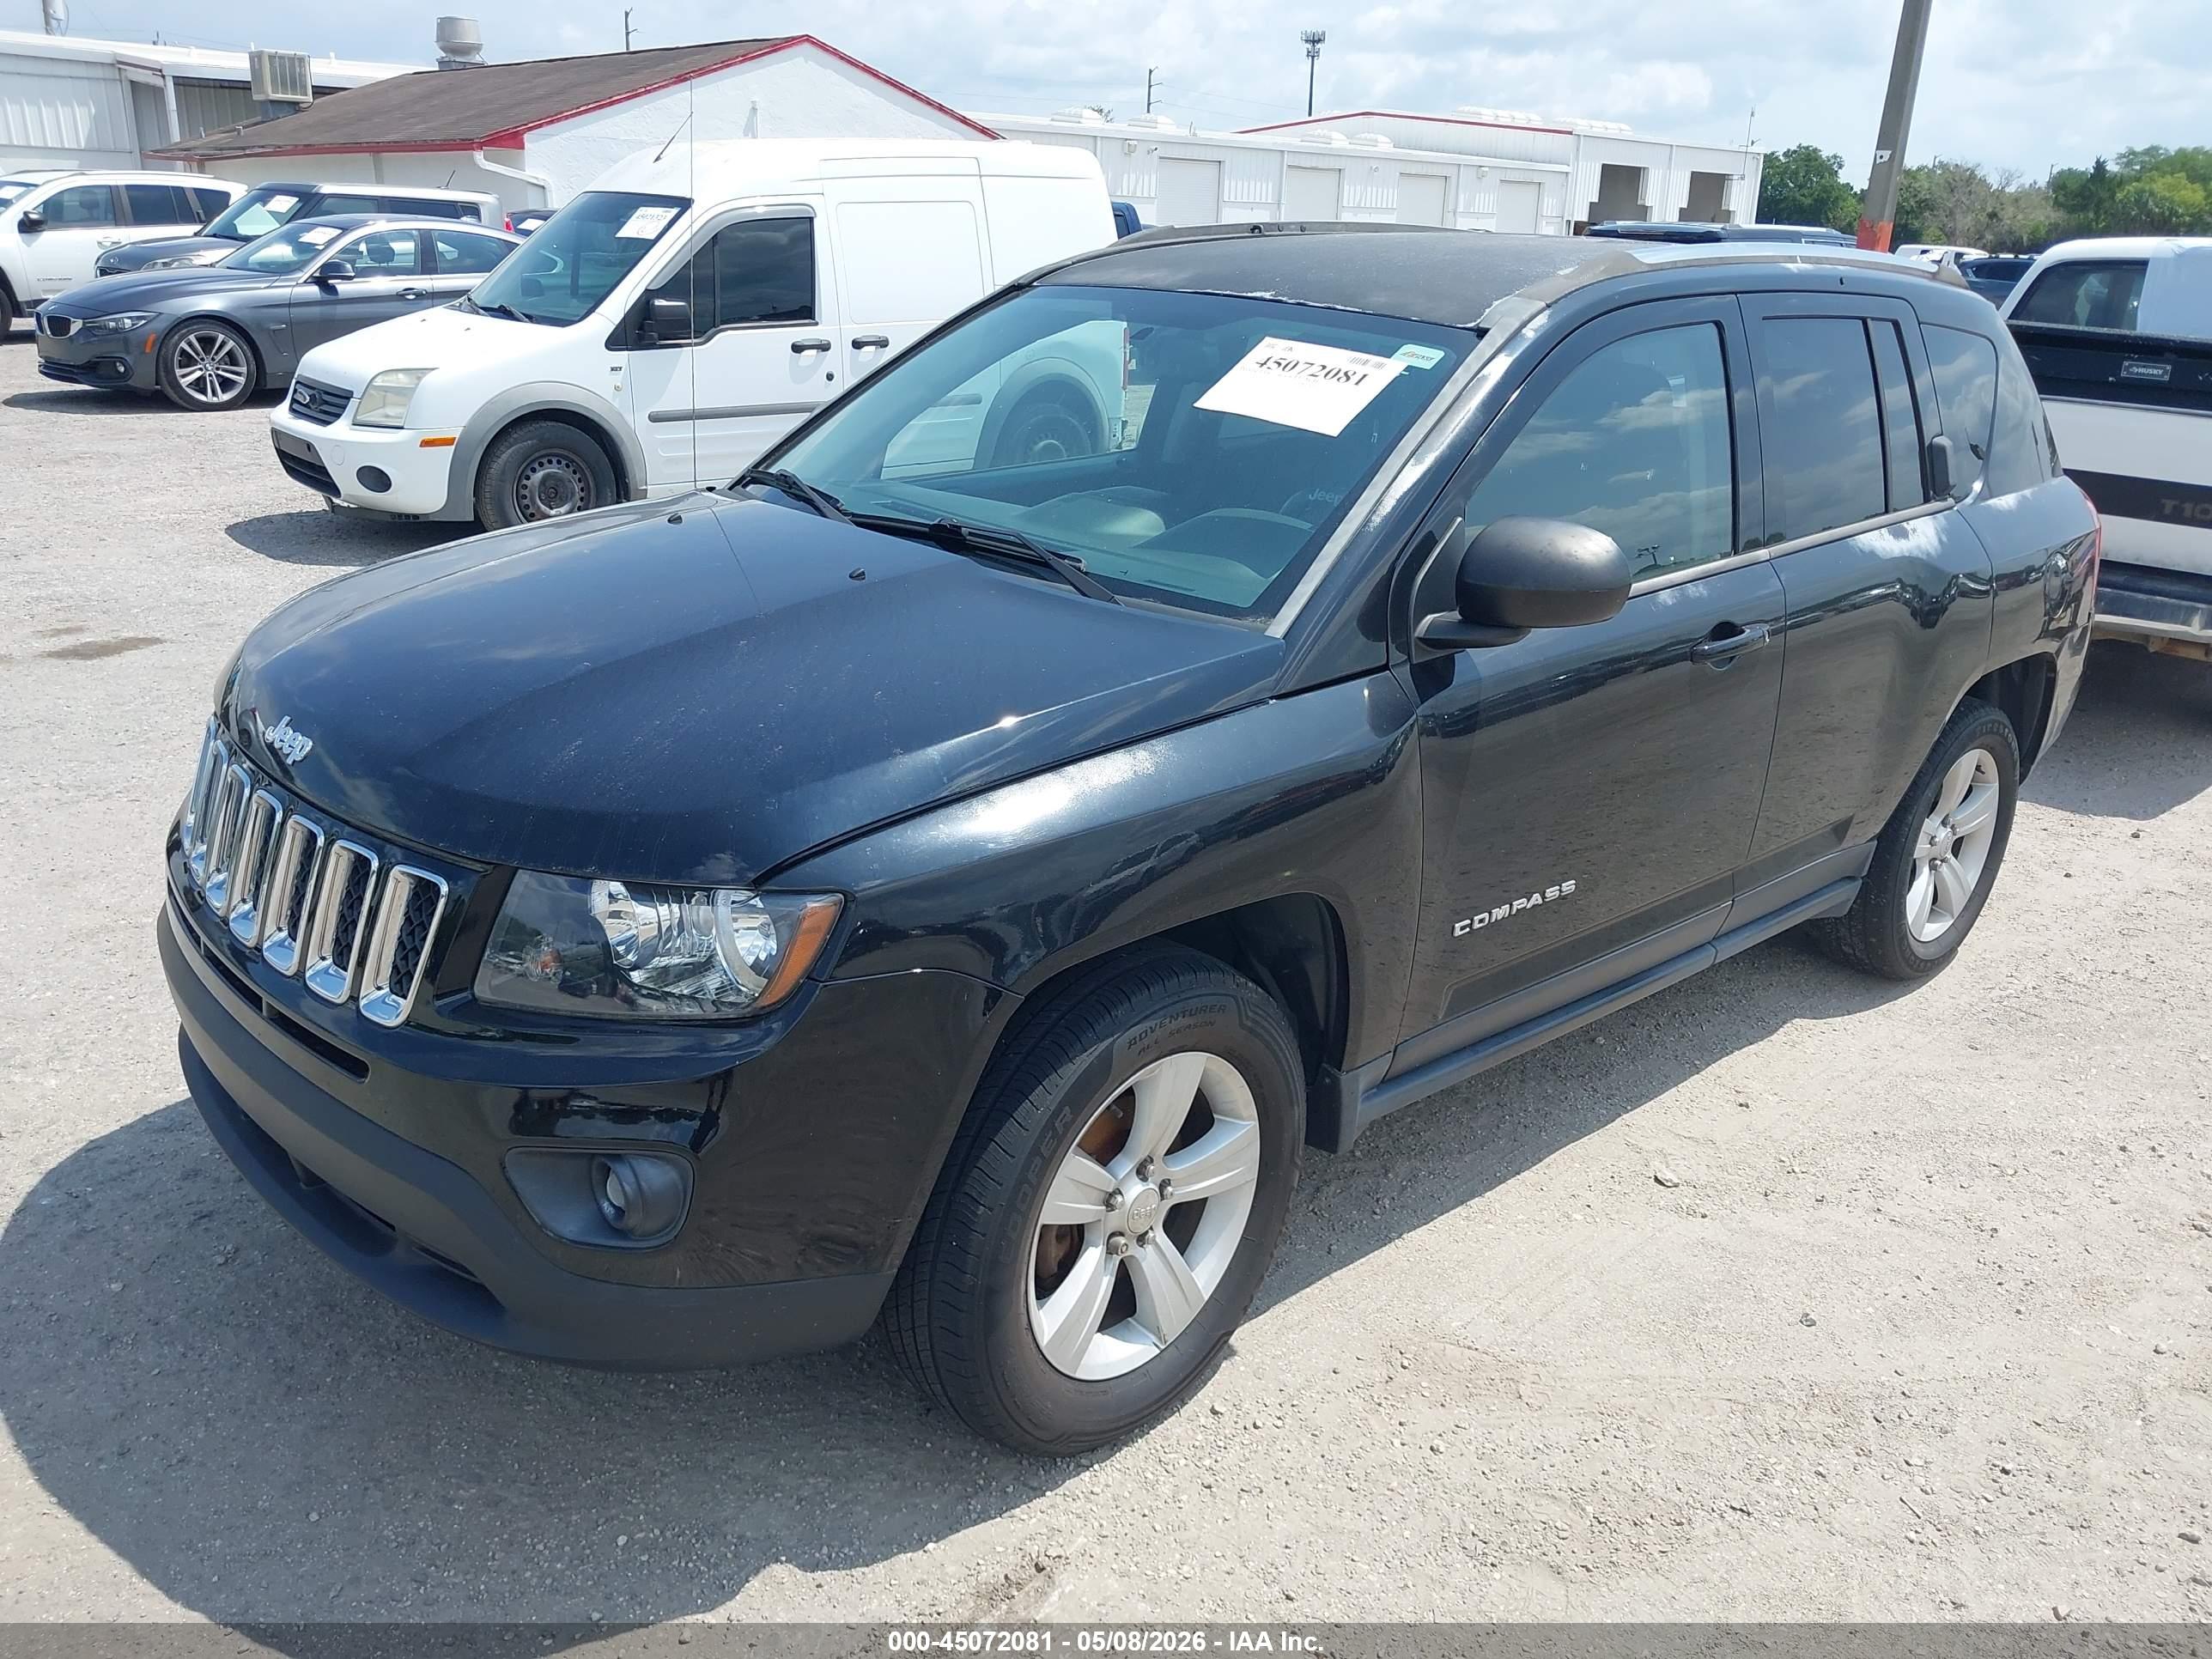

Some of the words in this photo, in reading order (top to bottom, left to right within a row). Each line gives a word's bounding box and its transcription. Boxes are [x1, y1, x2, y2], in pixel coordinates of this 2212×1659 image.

[1255, 355, 1369, 387] 45072081
[1309, 488, 1343, 507] Jeep
[264, 715, 313, 765] Jeep
[1453, 879, 1577, 937] COMPASS
[1127, 1003, 1227, 1051] ADVENTURER
[1168, 1019, 1217, 1038] SEASON
